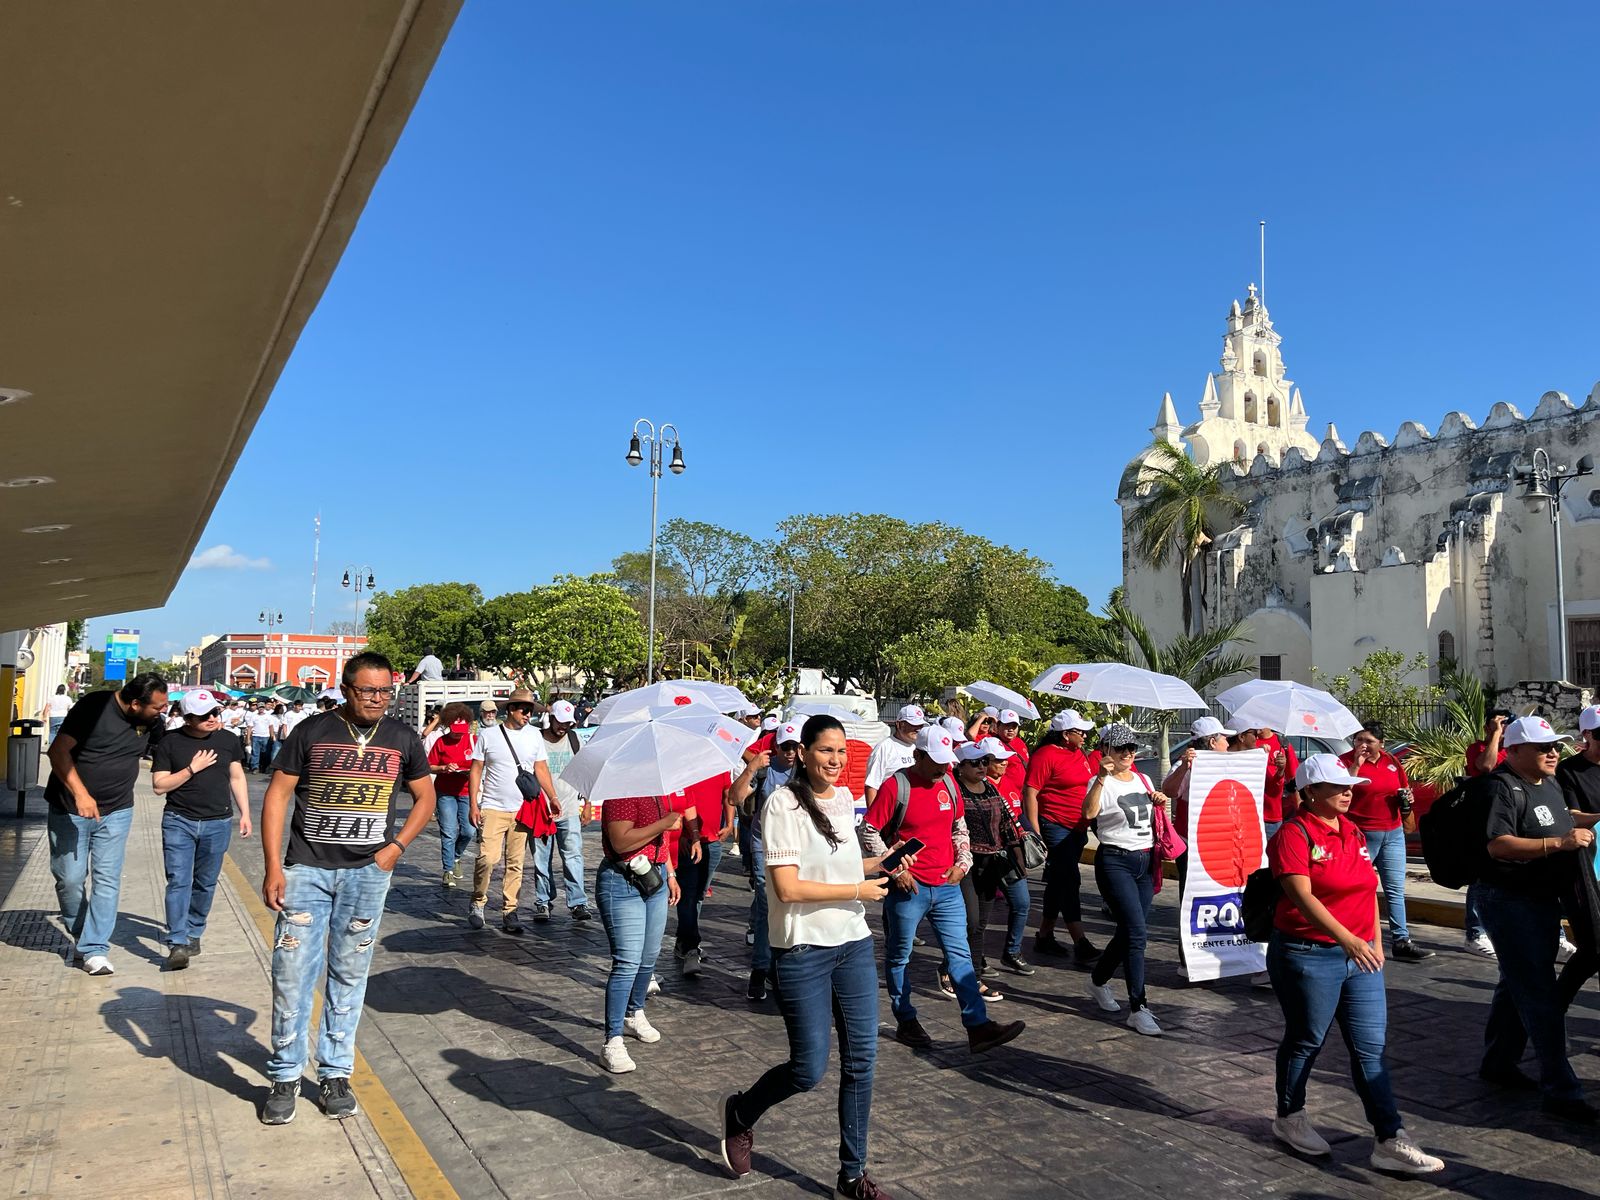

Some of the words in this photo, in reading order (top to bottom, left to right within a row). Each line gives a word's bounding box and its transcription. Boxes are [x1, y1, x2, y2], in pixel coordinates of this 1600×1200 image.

[319, 749, 393, 773] WORK
[320, 782, 384, 806] REST
[315, 816, 377, 839] PLAY
[1196, 901, 1245, 929] RO
[1192, 940, 1225, 949] FRENTE
